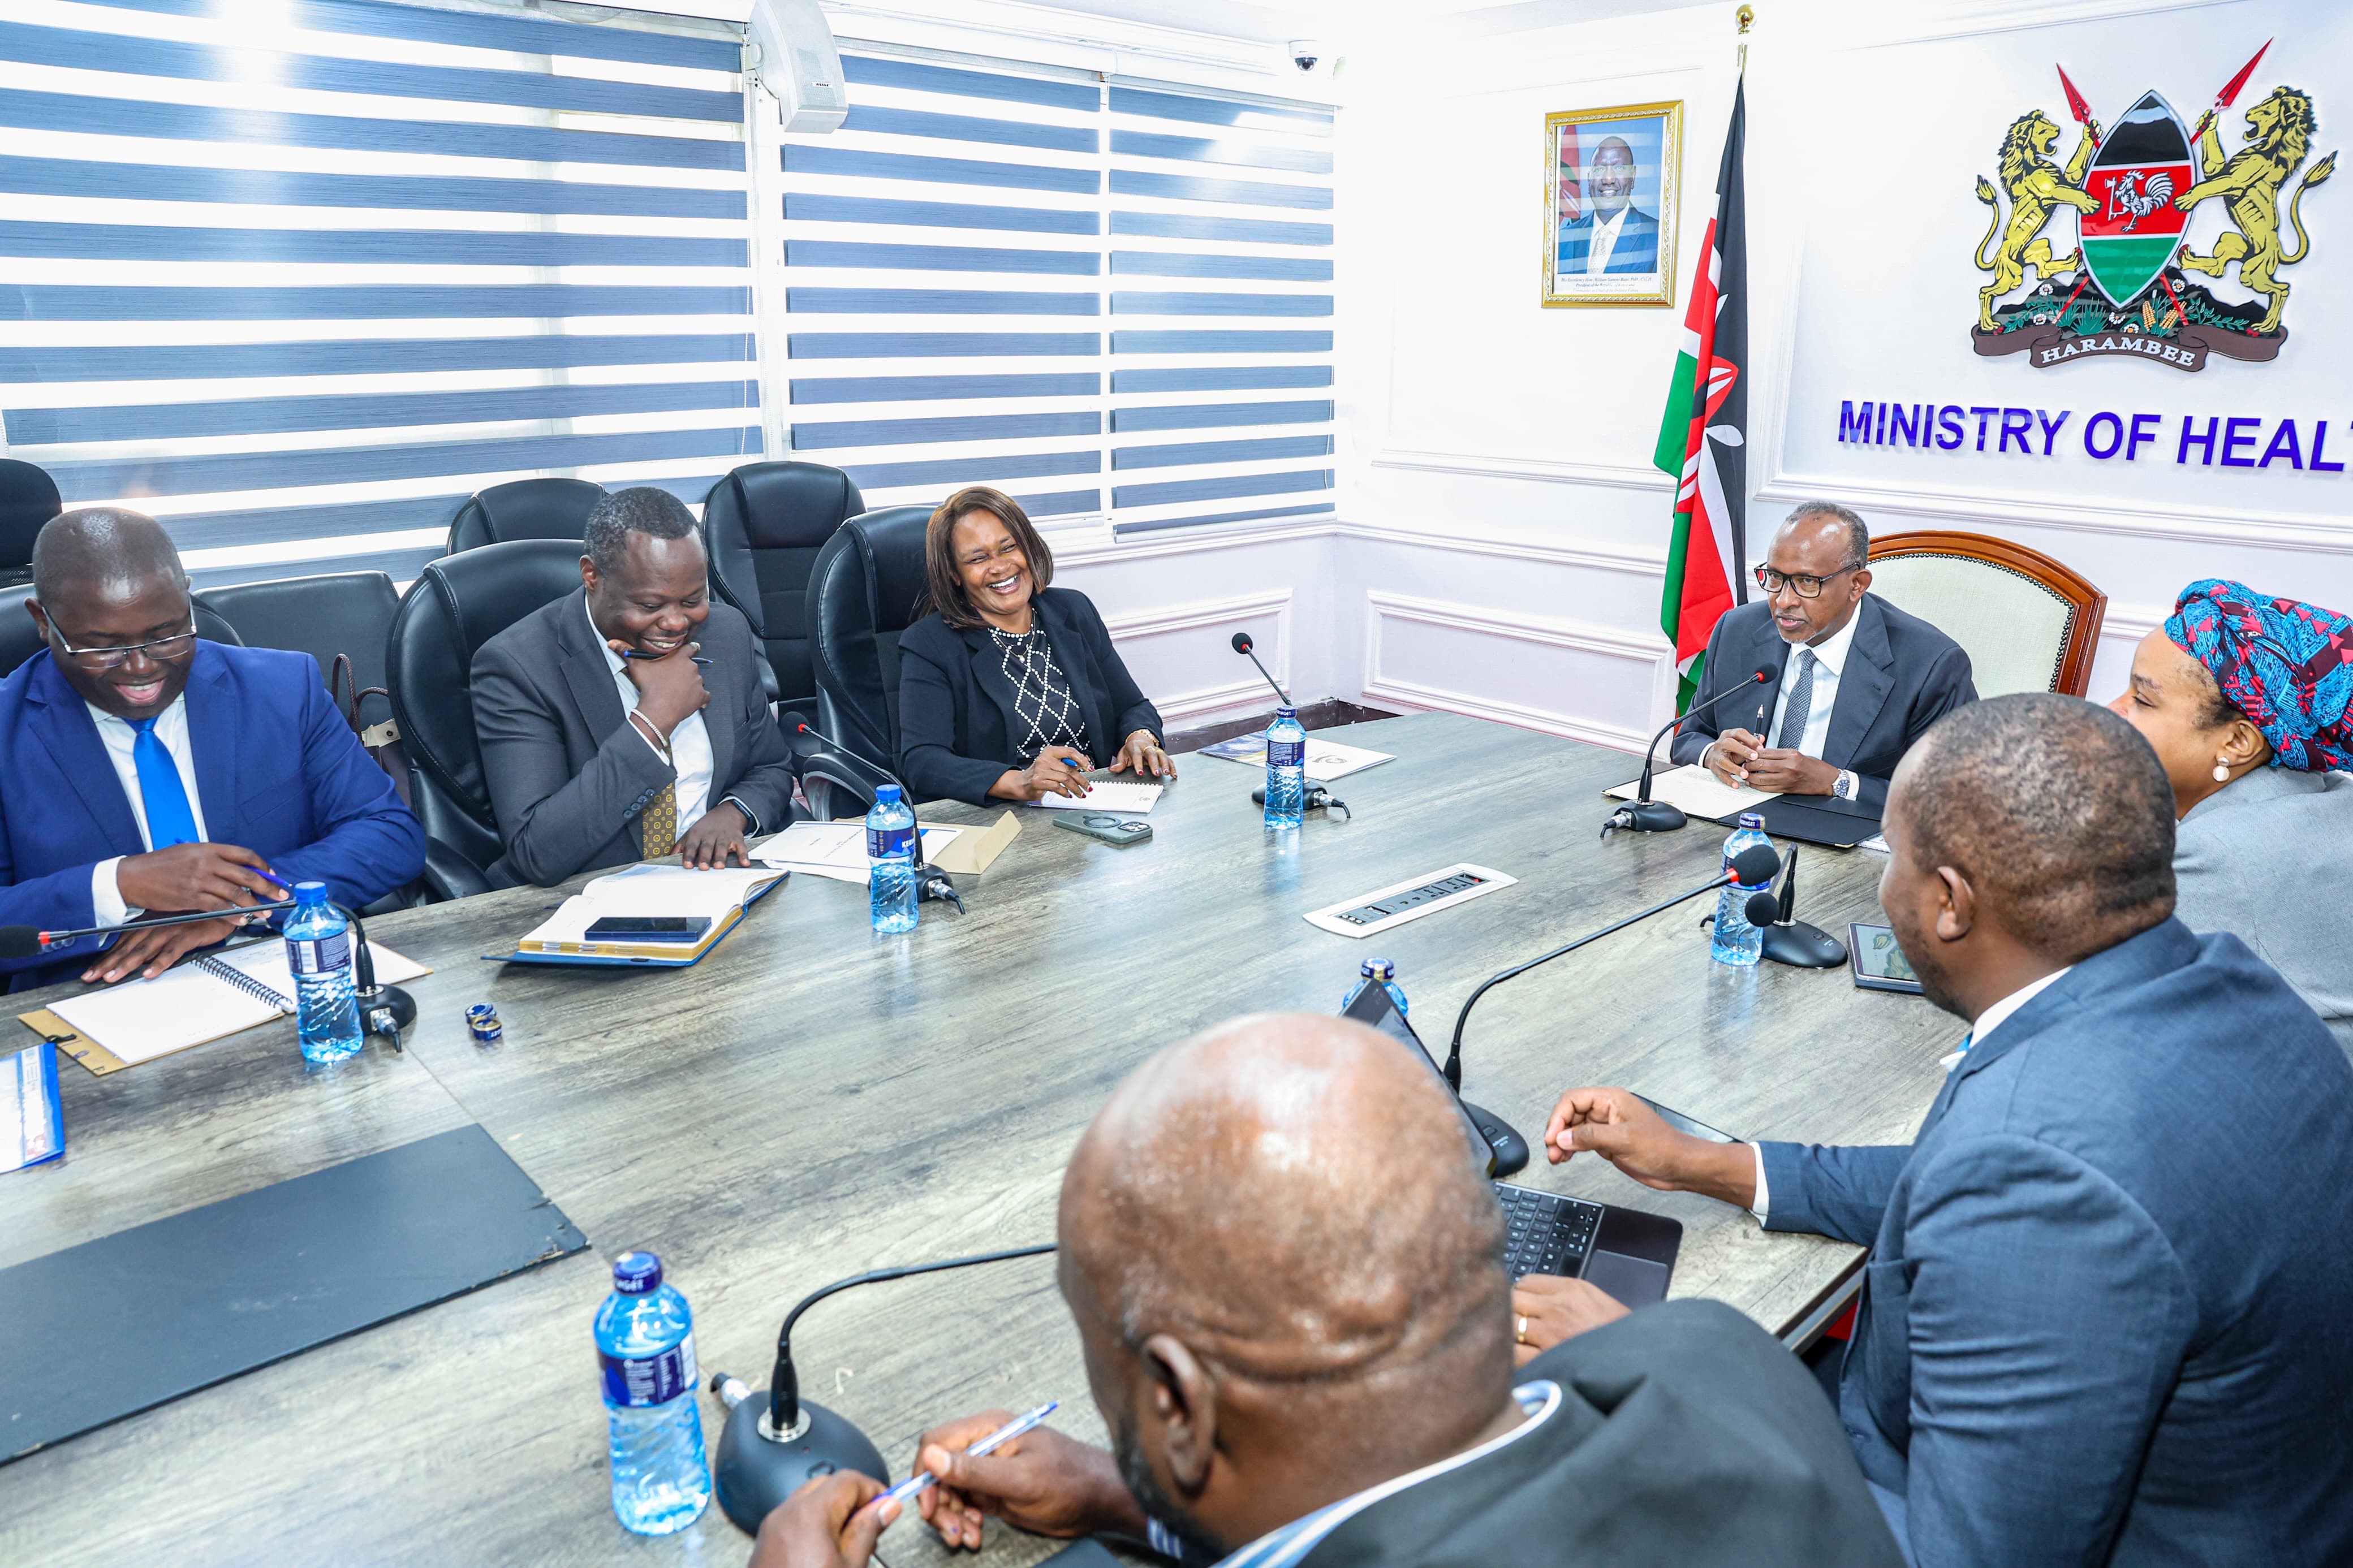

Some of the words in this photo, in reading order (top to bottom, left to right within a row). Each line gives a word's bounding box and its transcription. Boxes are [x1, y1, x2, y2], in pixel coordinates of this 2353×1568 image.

[2041, 337, 2195, 366] HARAMBEE
[1838, 400, 2071, 455] MINISTRY
[2084, 412, 2161, 460] OF
[2177, 416, 2353, 471] HEAL
